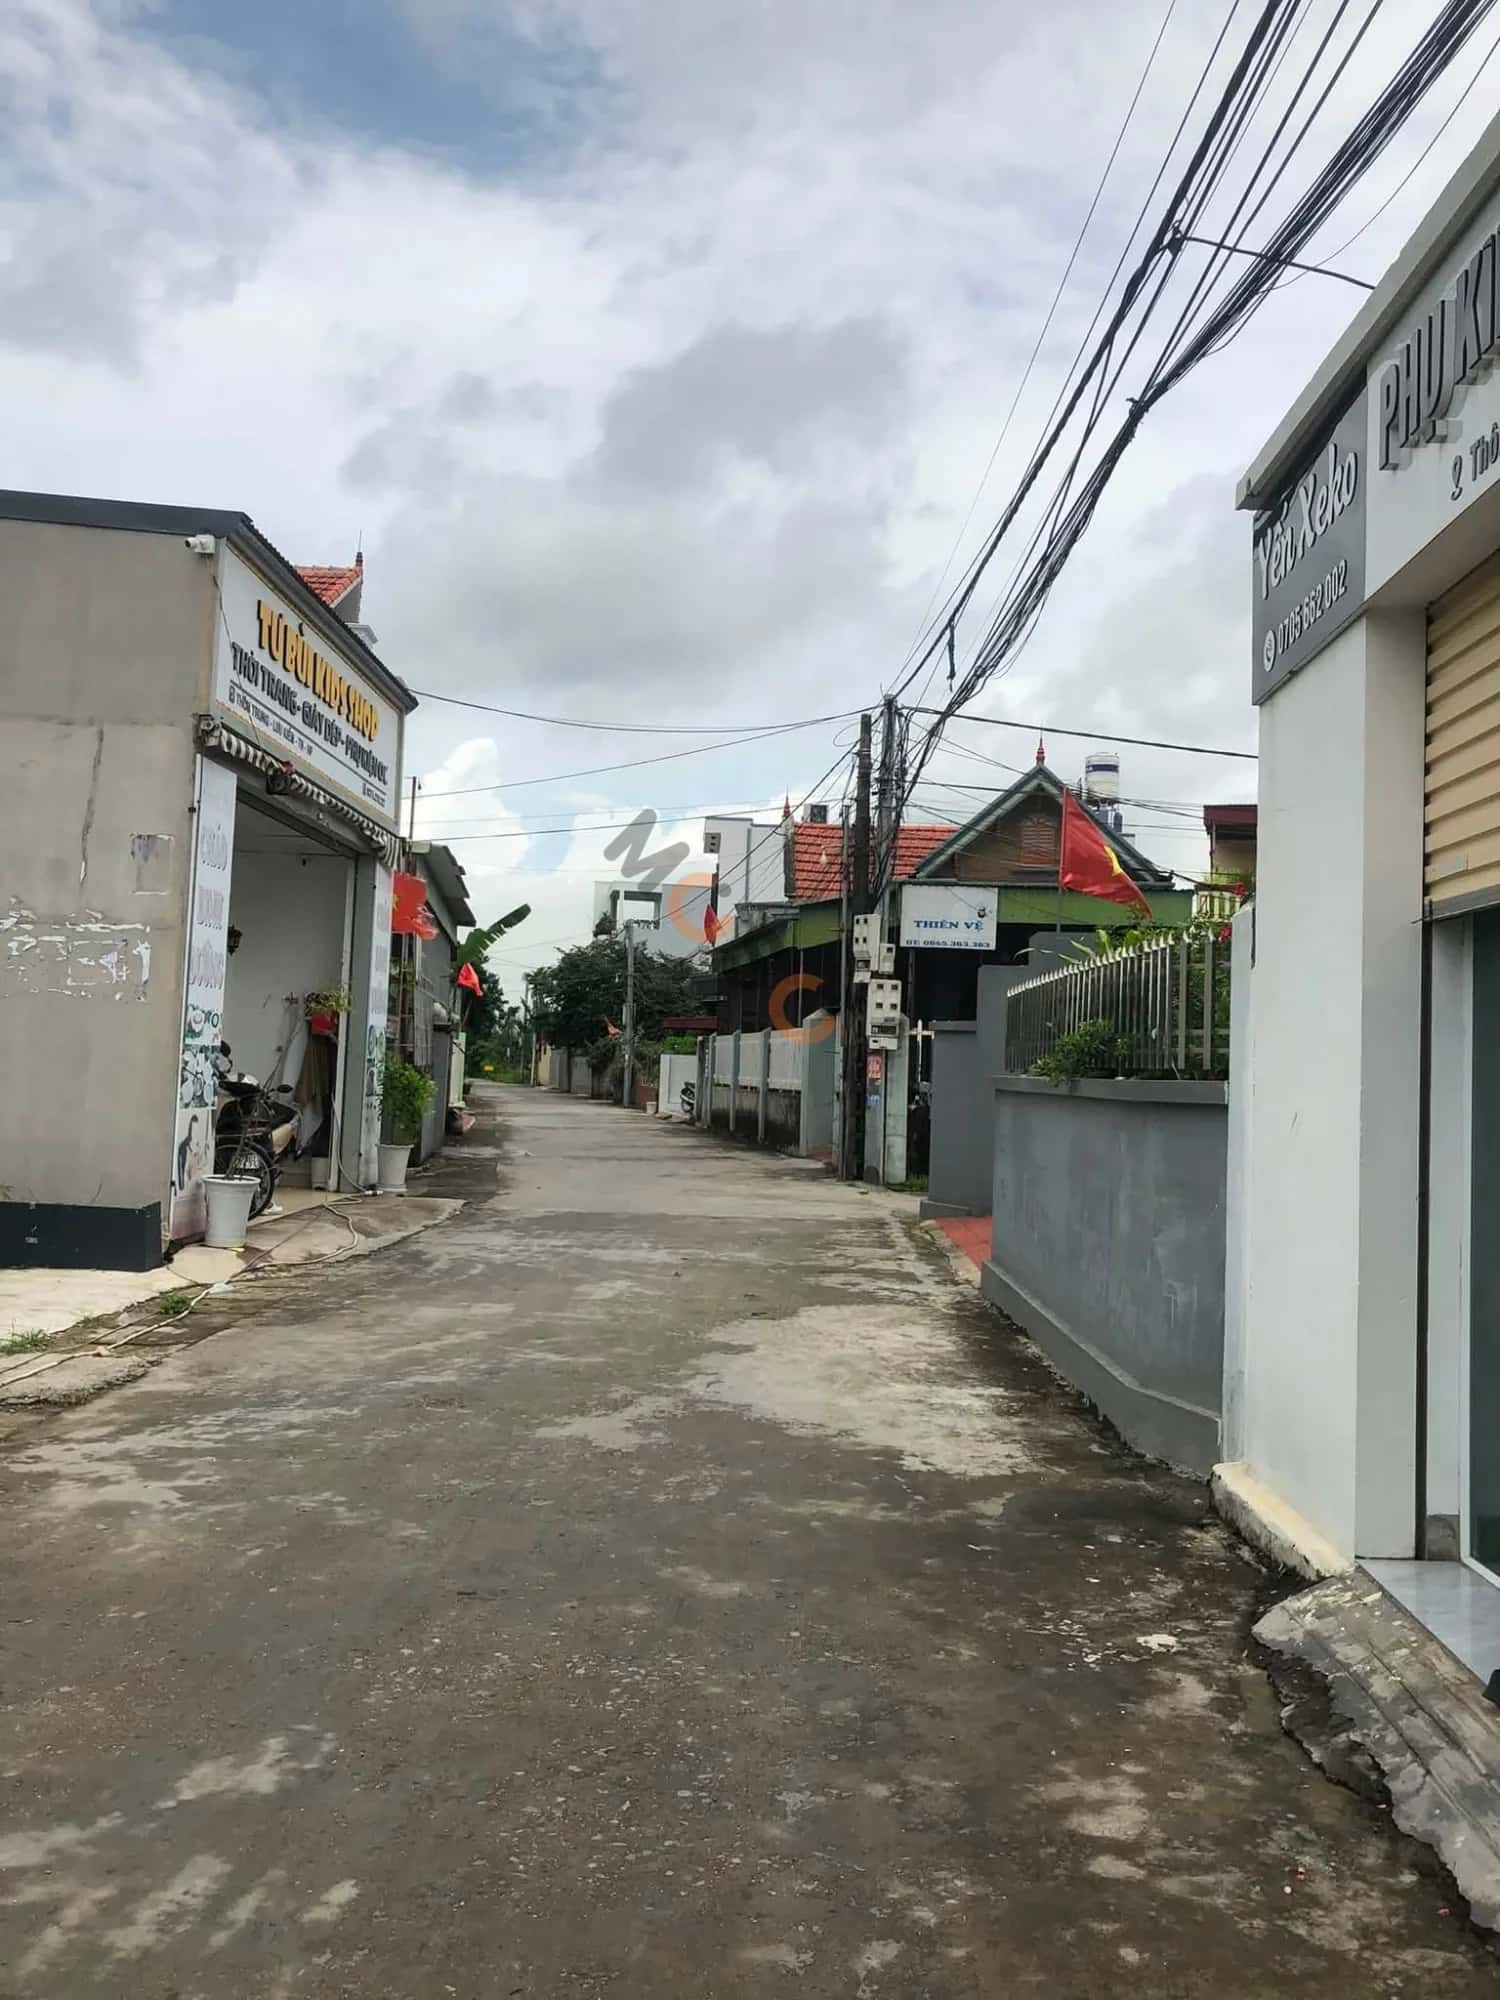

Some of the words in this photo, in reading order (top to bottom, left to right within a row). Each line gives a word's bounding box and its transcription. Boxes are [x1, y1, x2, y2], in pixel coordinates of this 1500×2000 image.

[1454, 224, 1500, 384] KI
[1297, 442, 1358, 561] Xeko
[1277, 603, 1303, 655] 0705
[1302, 583, 1325, 631] 662
[1324, 559, 1348, 610] 002
